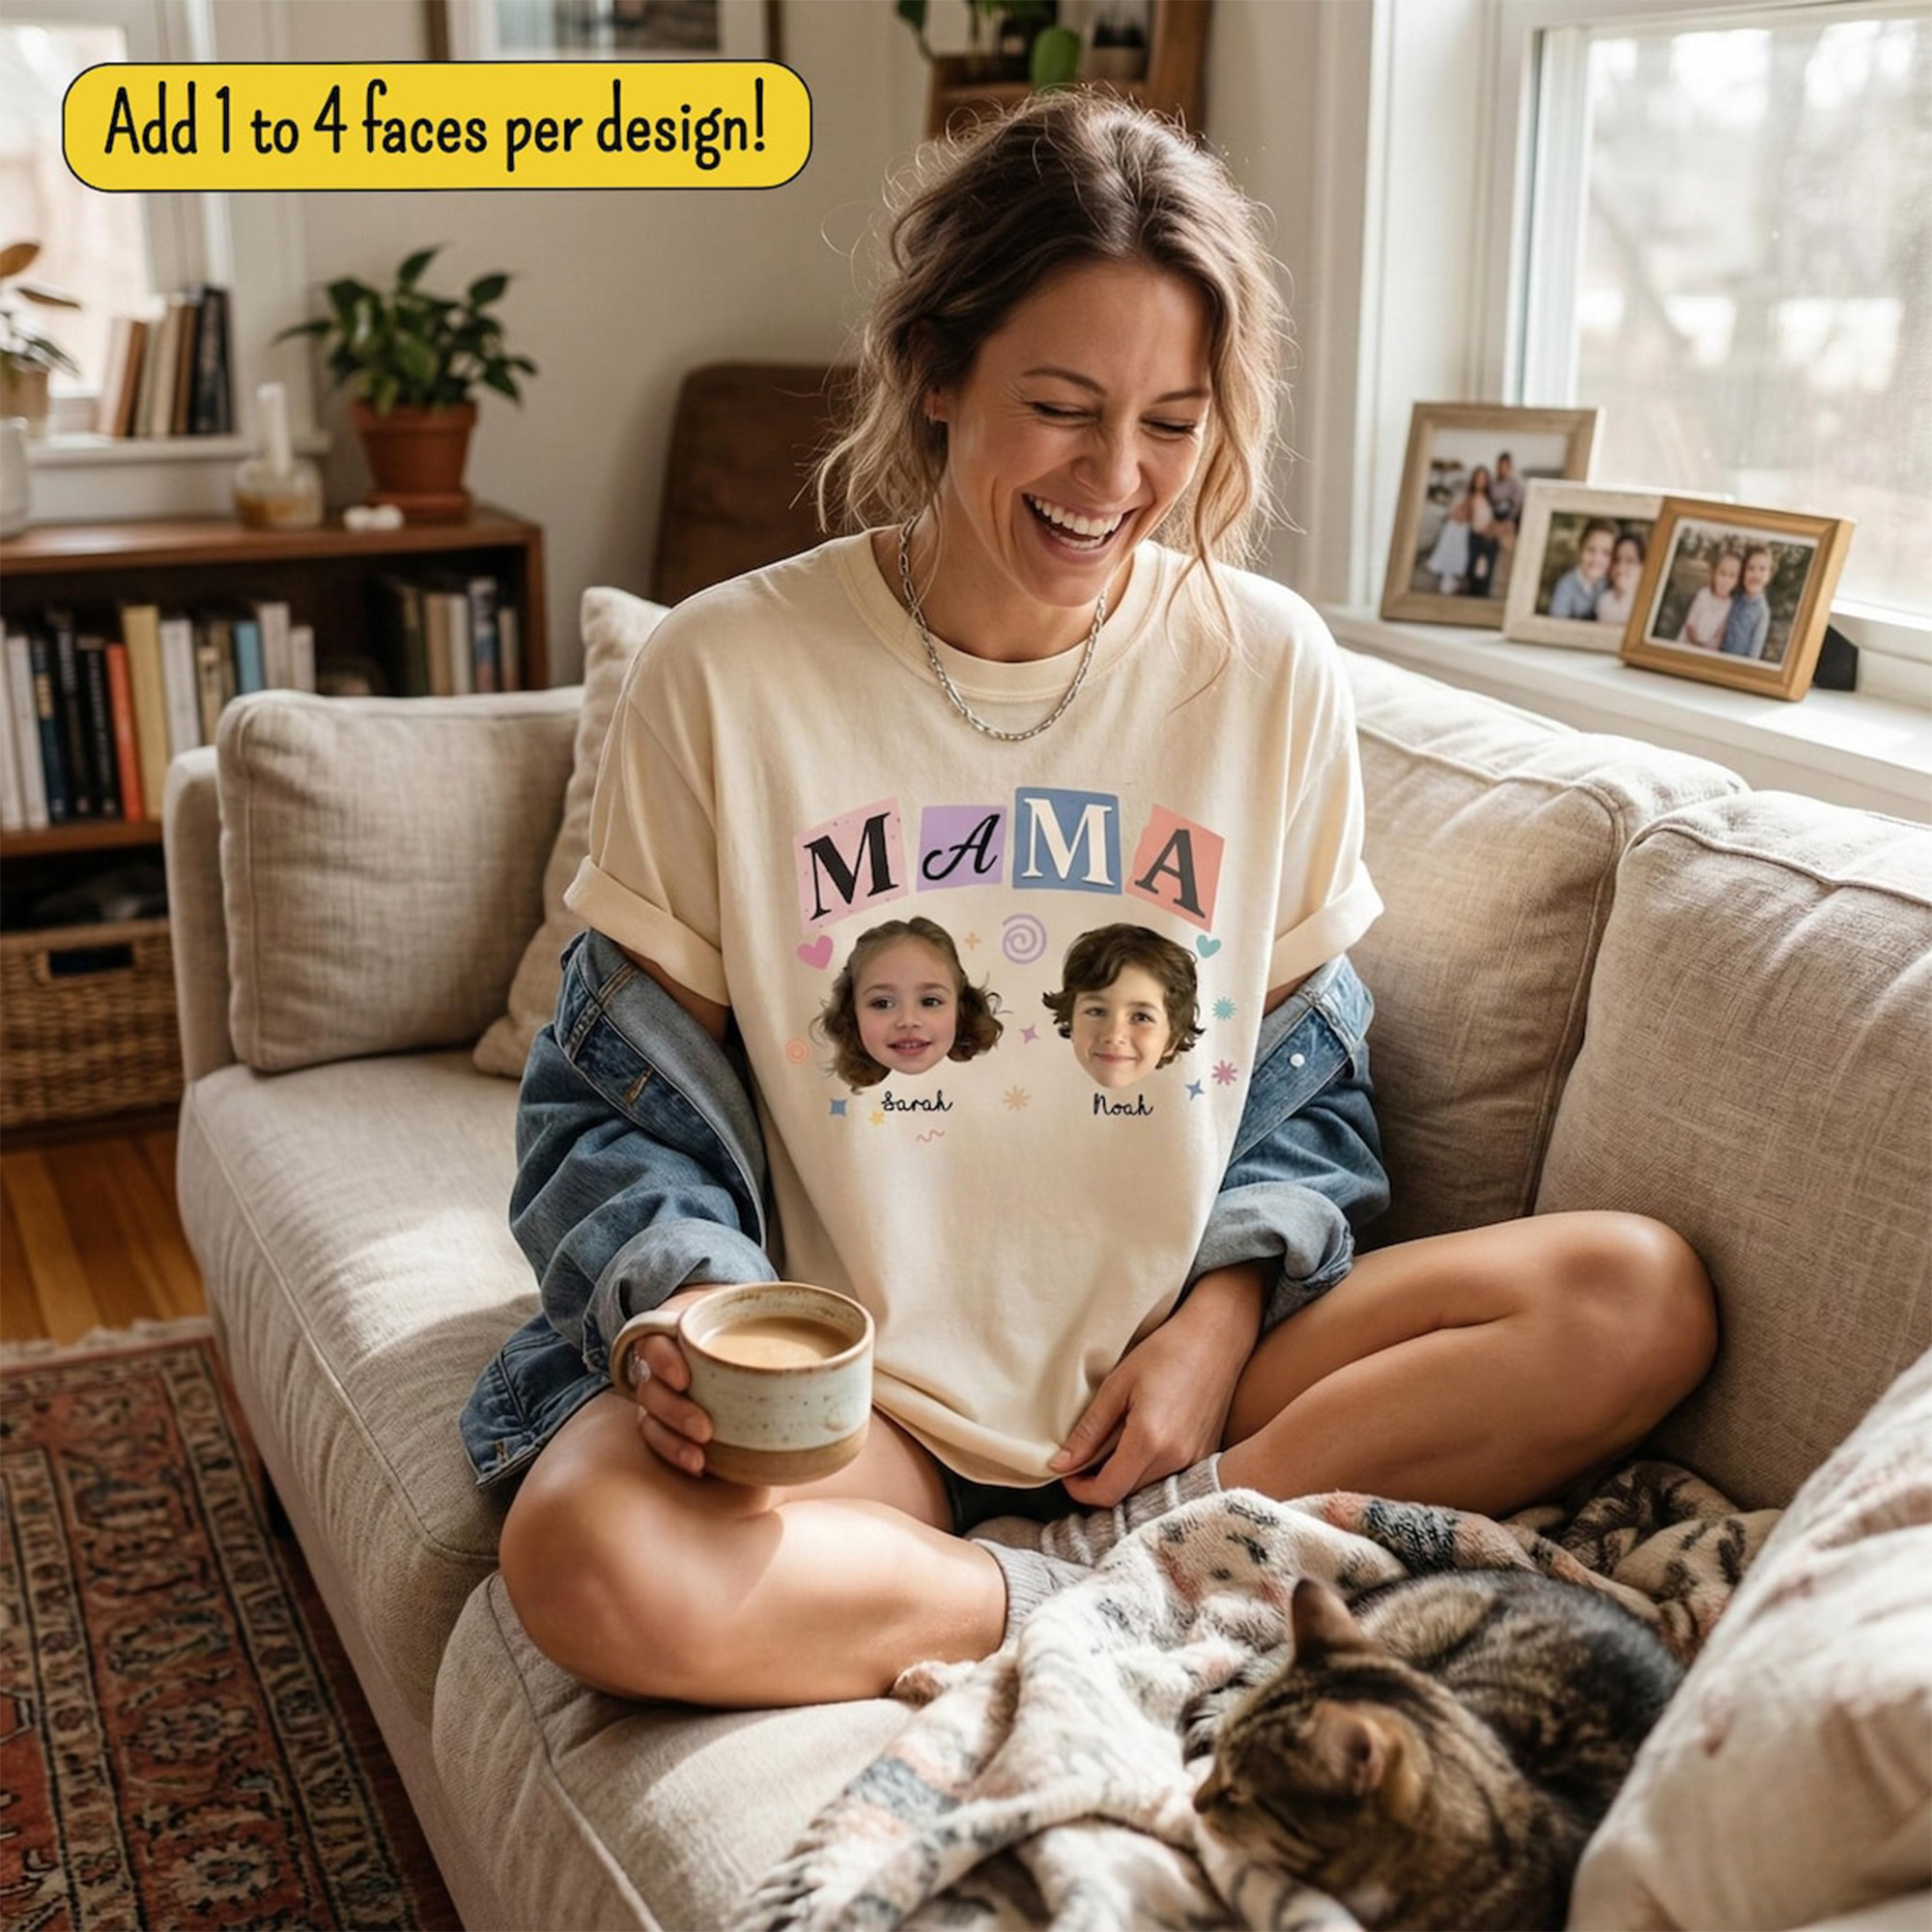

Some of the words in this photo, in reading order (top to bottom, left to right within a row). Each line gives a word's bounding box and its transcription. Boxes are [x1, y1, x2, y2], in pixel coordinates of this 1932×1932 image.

[803, 797, 1207, 922] MAMA
[881, 1090, 953, 1112] Sarah
[1094, 1093, 1154, 1117] Noah
